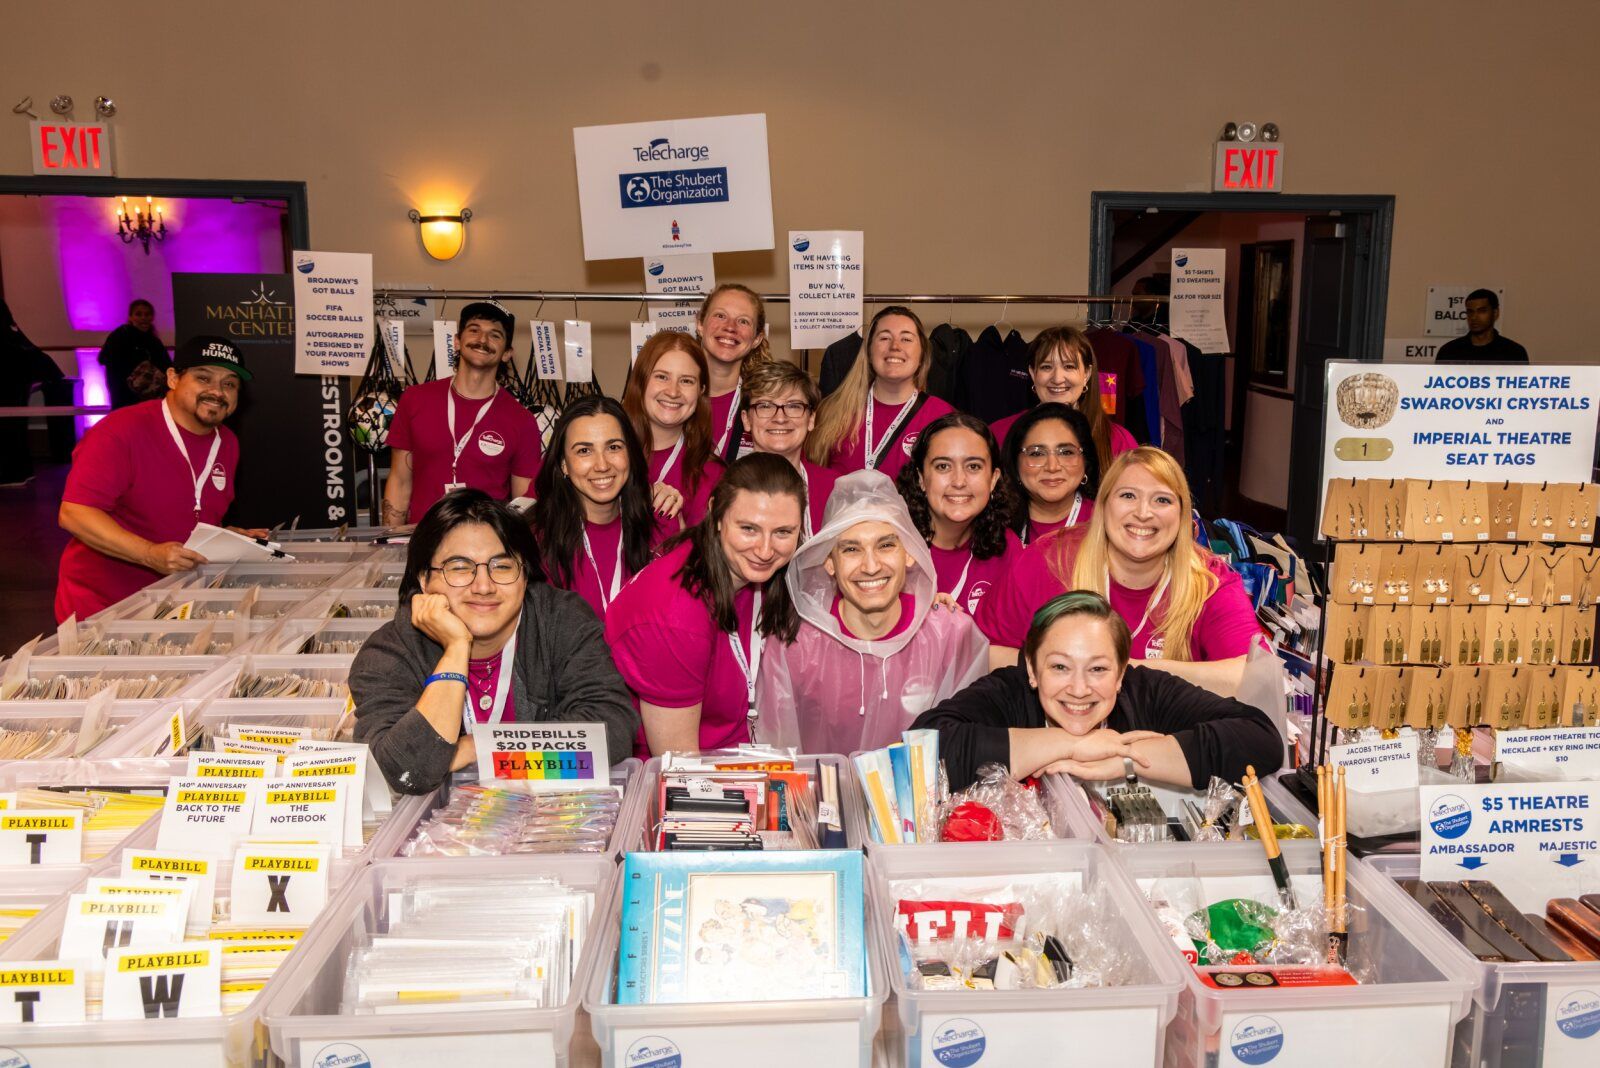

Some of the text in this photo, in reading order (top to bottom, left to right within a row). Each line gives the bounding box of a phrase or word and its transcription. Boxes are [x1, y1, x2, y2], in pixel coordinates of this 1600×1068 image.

[41, 126, 102, 168] EXIT
[633, 144, 708, 162] Telecharge
[1224, 149, 1278, 188] EXIT
[650, 172, 722, 188] The Shubert
[651, 186, 724, 202] Organization
[1448, 296, 1465, 308] 1ST
[206, 305, 295, 320] MANHATT
[1435, 311, 1468, 320] BALC
[544, 326, 552, 351] BUENA
[209, 343, 234, 354] STAY
[1406, 346, 1437, 357] EXIT
[202, 349, 239, 364] HUMAN
[1424, 376, 1571, 389] JACOBS THEATRE
[1400, 397, 1590, 410] SWAROVSKI CRYSTALS
[1413, 432, 1571, 445] IMPERIAL THEATRE
[321, 375, 345, 520] ESTROOMS &
[1362, 442, 1367, 456] 1
[1446, 453, 1536, 466] SEAT TAGS
[493, 730, 587, 739] PRIDEBILLS
[240, 744, 286, 754] ANNIVERSARY
[496, 742, 587, 751] $20 PACKS
[1347, 742, 1402, 755] JACOBS THEATRE
[310, 756, 356, 765] ANNIVERSARY
[499, 760, 589, 770] PLAYBILL
[1339, 752, 1411, 766] SWAROVSKI CRYSTALS
[203, 768, 258, 778] PLAYBILL
[299, 766, 350, 776] PLAYBILL
[184, 793, 239, 802] PLAYBILL
[274, 792, 330, 801] PLAYBILL
[1432, 804, 1466, 816] Telecharge
[1482, 795, 1589, 812] $5 THEATRE
[9, 819, 68, 828] PLAYBILL
[187, 815, 226, 823] FUTURE
[270, 814, 327, 823] NOTEBOOK
[1488, 818, 1584, 834] ARMRESTS
[26, 834, 47, 864] T
[1429, 840, 1597, 854] AMBASSADOR MAJESTIC
[140, 859, 201, 872] PLAYBILL
[252, 859, 312, 869] PLAYBILL
[267, 875, 291, 912] X
[89, 904, 159, 914] PLAYBILL
[128, 954, 201, 968] PLAYBILL
[0, 973, 66, 983] LAYBILL
[139, 973, 185, 1018] W
[15, 991, 40, 1022] T
[936, 1029, 978, 1042] Telecharge
[1235, 1026, 1276, 1040] Telecharge
[630, 1046, 673, 1062] Telecharge
